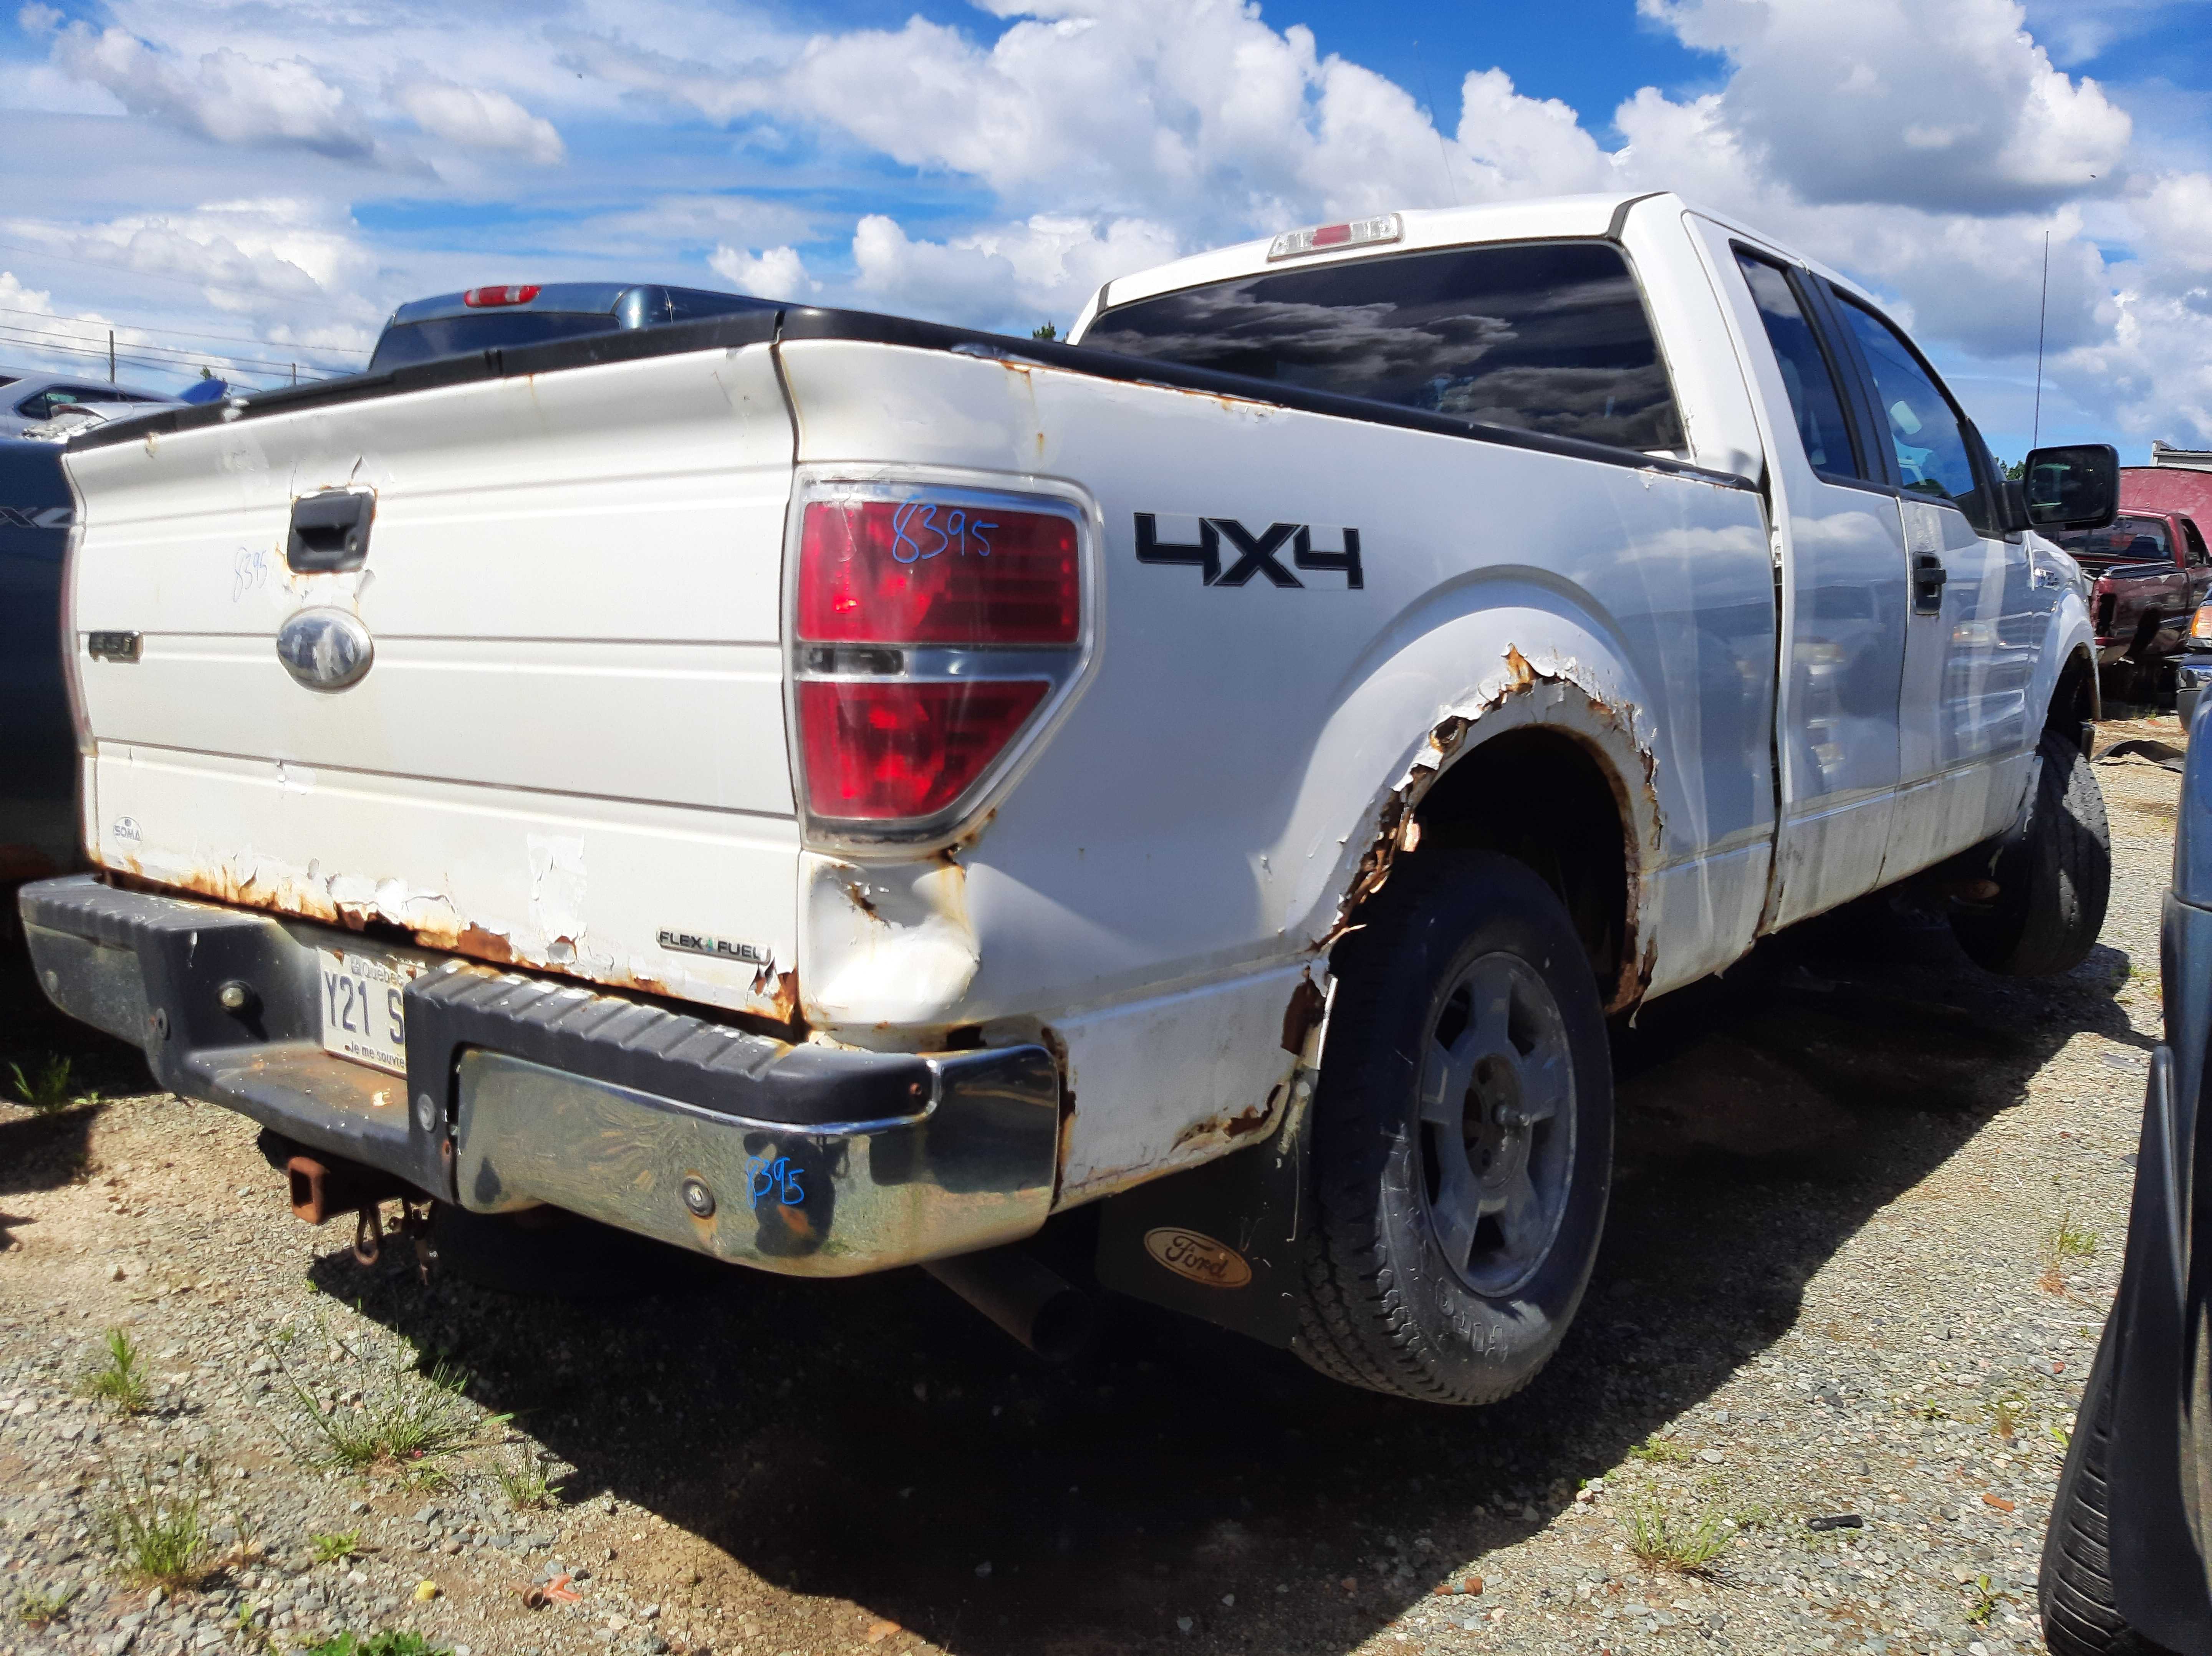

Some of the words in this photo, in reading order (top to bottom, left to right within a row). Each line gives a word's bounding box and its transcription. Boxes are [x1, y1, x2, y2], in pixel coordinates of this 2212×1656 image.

[892, 495, 999, 564] 8395
[1133, 512, 1364, 590] 4X4
[233, 547, 267, 602] 8395
[114, 825, 141, 841] SOMA
[660, 931, 703, 950] FLEX
[717, 941, 761, 960] FUEL
[325, 971, 371, 1036] Y21
[350, 1040, 359, 1054] Je
[362, 1046, 374, 1059] me
[1165, 1235, 1228, 1278] Ford
